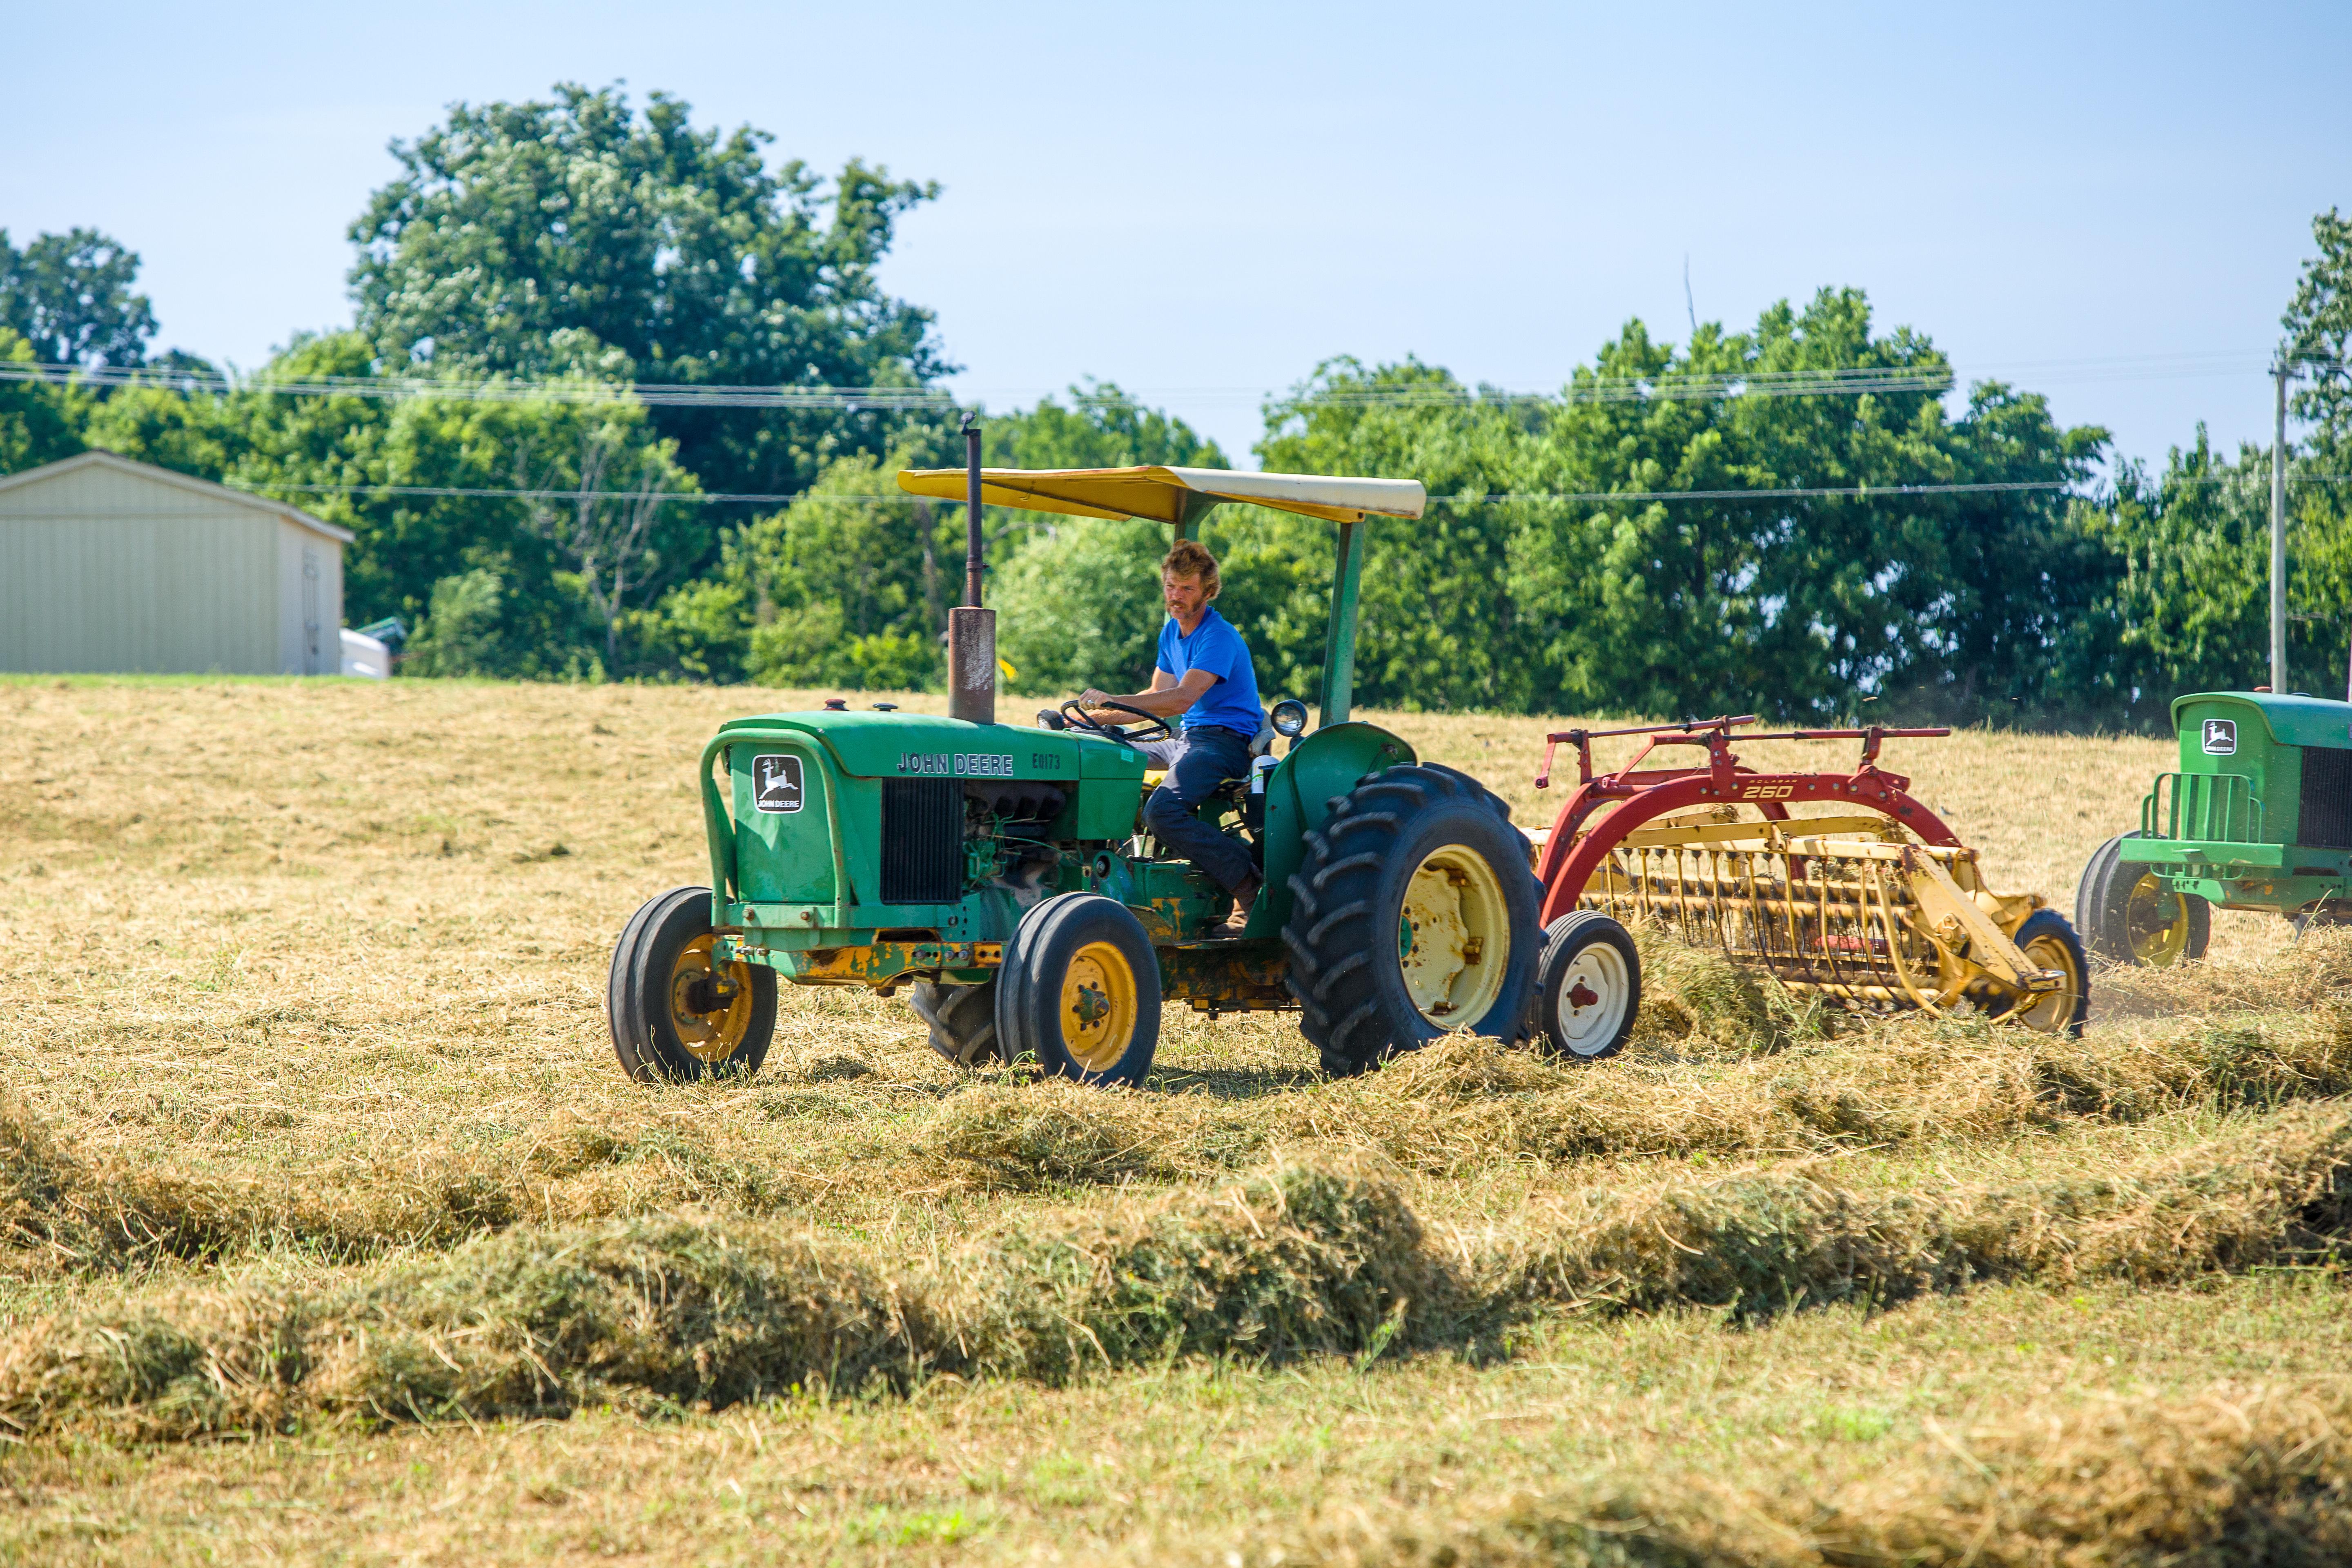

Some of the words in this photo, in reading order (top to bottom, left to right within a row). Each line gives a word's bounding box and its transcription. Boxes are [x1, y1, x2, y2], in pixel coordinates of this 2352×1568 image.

[897, 753, 949, 774] JOHN
[954, 754, 1013, 776] DEERE
[1742, 786, 1794, 798] 260
